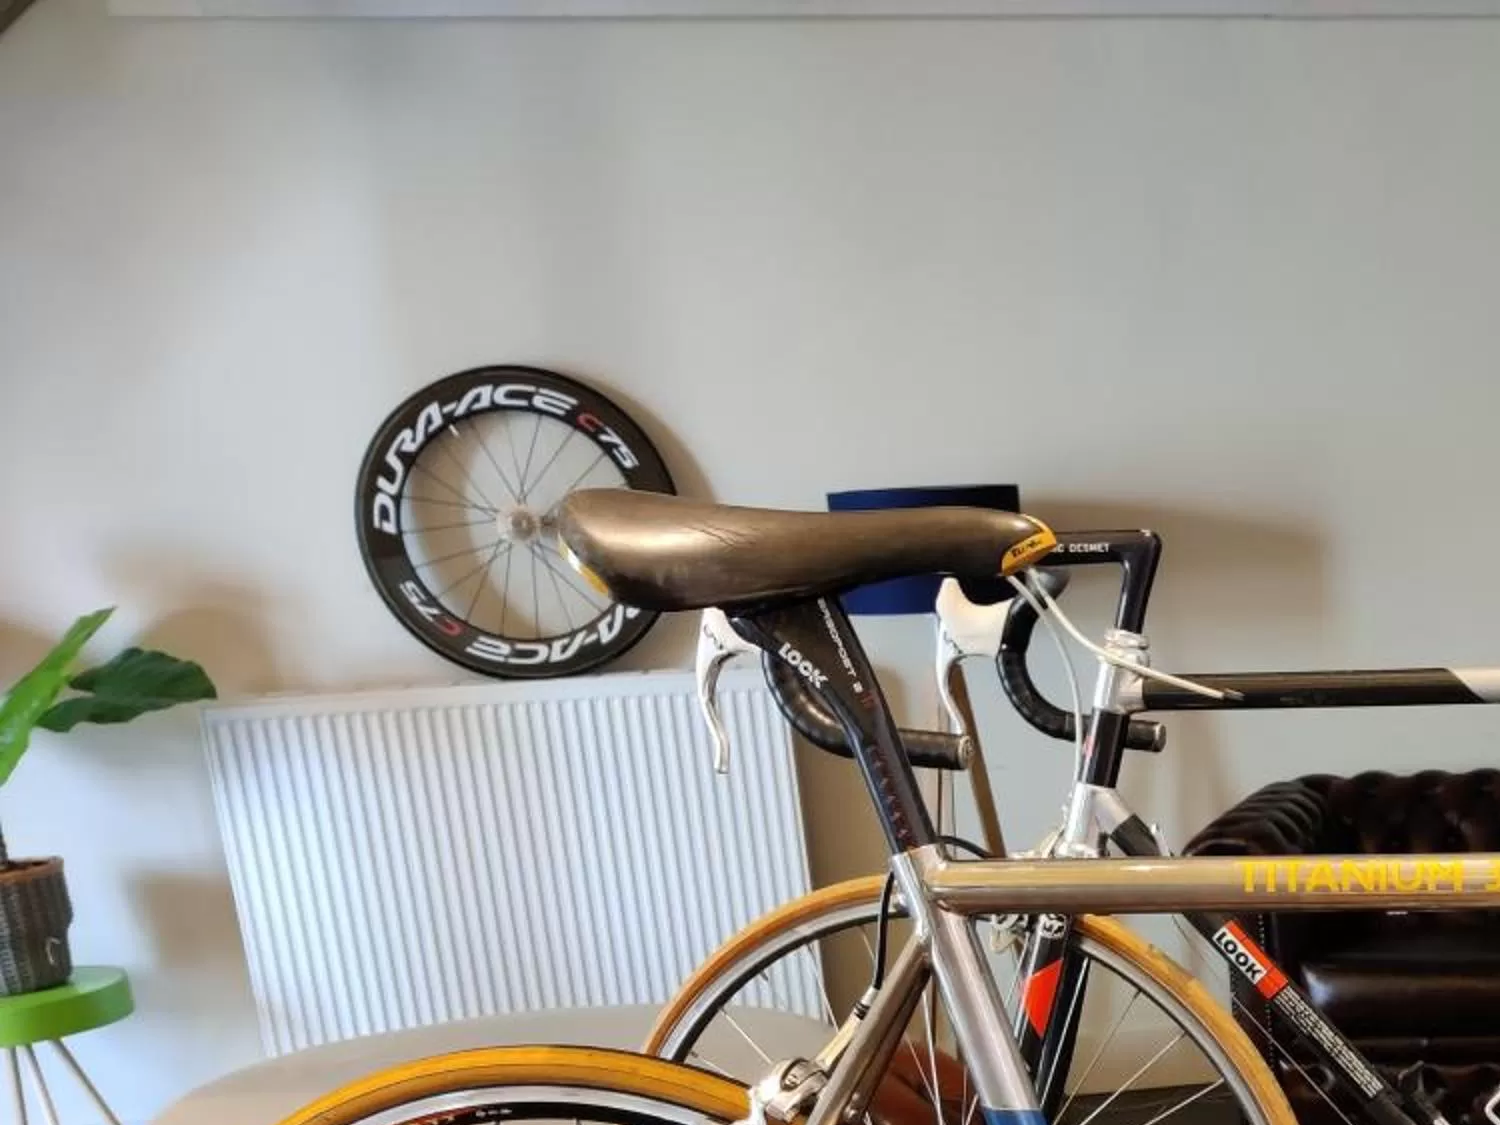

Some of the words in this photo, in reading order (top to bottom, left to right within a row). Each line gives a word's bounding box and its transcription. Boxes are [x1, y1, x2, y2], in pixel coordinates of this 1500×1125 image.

[373, 383, 578, 535] DURA-ACE
[576, 412, 640, 470] C75
[399, 579, 465, 636] C75
[464, 603, 640, 664] A-ACE
[777, 641, 829, 690] LOOK
[1235, 857, 1465, 893] TITANIUM
[1214, 931, 1263, 983] LOOK
